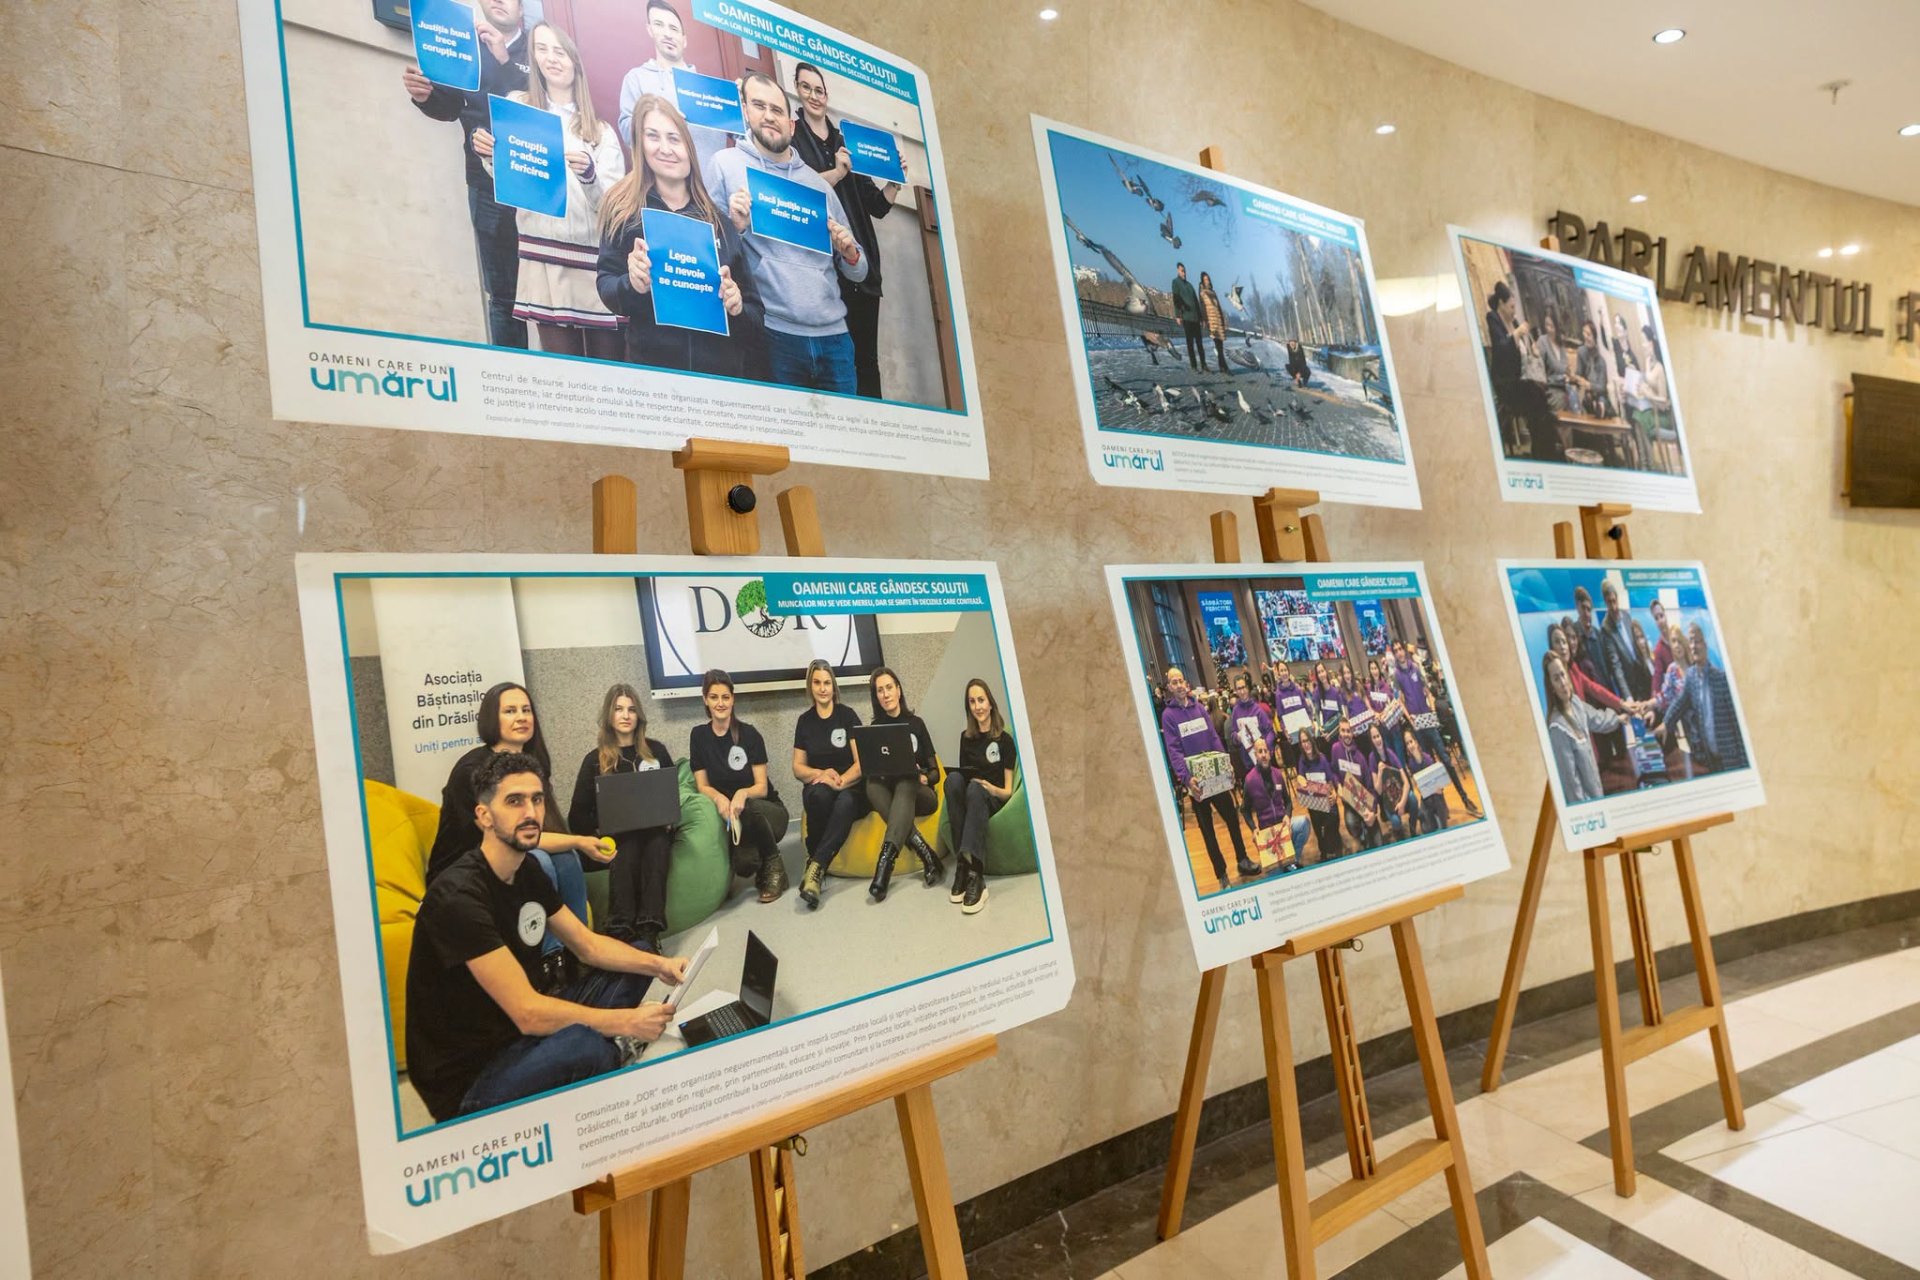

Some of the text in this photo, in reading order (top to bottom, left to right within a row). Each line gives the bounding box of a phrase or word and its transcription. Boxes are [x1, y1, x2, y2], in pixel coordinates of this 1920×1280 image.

[418, 22, 471, 39] Justiția bună
[435, 35, 457, 46] trece
[703, 12, 729, 25] MUNCA
[730, 21, 742, 31] LOR
[742, 26, 753, 36] NU
[754, 31, 762, 39] SE
[763, 34, 778, 46] VEDE
[779, 40, 802, 55] MEREU,
[802, 50, 815, 60] DAR
[823, 57, 839, 69] SIMTE
[840, 64, 847, 73] ÎN
[871, 77, 884, 88] CARE
[719, 2, 897, 84] OAMENII CARE GÂNDESC SOLUȚII
[422, 43, 473, 61] corupția rea
[508, 135, 548, 154] Corupția
[510, 149, 548, 166] n-aduce
[511, 160, 549, 179] fericirea
[758, 192, 818, 218] Dacă justiție nu e,
[771, 208, 809, 225] nimic nu e!
[669, 249, 697, 265] Legea
[665, 263, 706, 279] la nevoie
[1557, 210, 1884, 338] PARLAMENTUL
[659, 277, 713, 293] se cunoaște
[309, 351, 448, 375] OAMENI CARE PUN
[310, 367, 458, 402] umărul
[481, 371, 513, 383] Centrul
[517, 375, 528, 384] de
[532, 376, 564, 388] Resurse
[568, 381, 598, 393] Juridice
[601, 385, 613, 394] din
[617, 387, 650, 398] Moldova
[652, 392, 667, 400] este
[671, 393, 708, 406] organizația
[482, 384, 540, 399] transparente,
[542, 391, 552, 399] iar
[555, 392, 595, 404] drepturile
[597, 397, 622, 407] omului
[625, 399, 634, 407] să
[635, 400, 645, 409] fie
[688, 405, 701, 414] Prin
[703, 408, 736, 420] cercetare,
[484, 397, 495, 405] de
[497, 399, 525, 410] justiție
[528, 402, 534, 411] și
[536, 403, 573, 414] intervine
[575, 407, 596, 415] acolo
[599, 409, 617, 417] unde
[619, 411, 635, 419] este
[637, 413, 661, 422] nevoie
[673, 416, 703, 427] claritate,
[792, 579, 968, 597] OAMENII CARE GÂNDESC SOLUȚII
[778, 600, 803, 608] MUNCA
[852, 599, 875, 608] MEREU,
[895, 598, 912, 606] SIMTE
[912, 597, 919, 606] ÎN
[424, 671, 482, 687] Asociația
[417, 691, 487, 709] Băștinașilo
[412, 715, 434, 730] din
[415, 742, 439, 754] Uniți
[441, 737, 474, 751] pentru
[1201, 904, 1225, 918] OAMENI
[1227, 901, 1242, 909] CARE
[575, 1099, 630, 1122] Comunitatea
[661, 1084, 678, 1095] este
[680, 1069, 722, 1089] organizația
[723, 1047, 790, 1074] neguvernamentală
[790, 1042, 805, 1051] care
[576, 1115, 621, 1137] Drăsliceni,
[624, 1110, 638, 1122] dar
[641, 1106, 648, 1117] și
[651, 1099, 674, 1112] satele
[676, 1092, 689, 1104] din
[691, 1083, 722, 1099] regiune,
[724, 1077, 740, 1089] prin
[789, 1051, 815, 1066] educare
[817, 1048, 823, 1057] și
[853, 1033, 867, 1043] Prin
[578, 1128, 629, 1151] evenimente
[630, 1114, 669, 1134] culturale,
[671, 1100, 713, 1120] organizația
[752, 1083, 759, 1092] la
[760, 1069, 803, 1089] consolidarea
[403, 1125, 543, 1178] OAMENI CARE PUN
[405, 1122, 553, 1207] umărul
